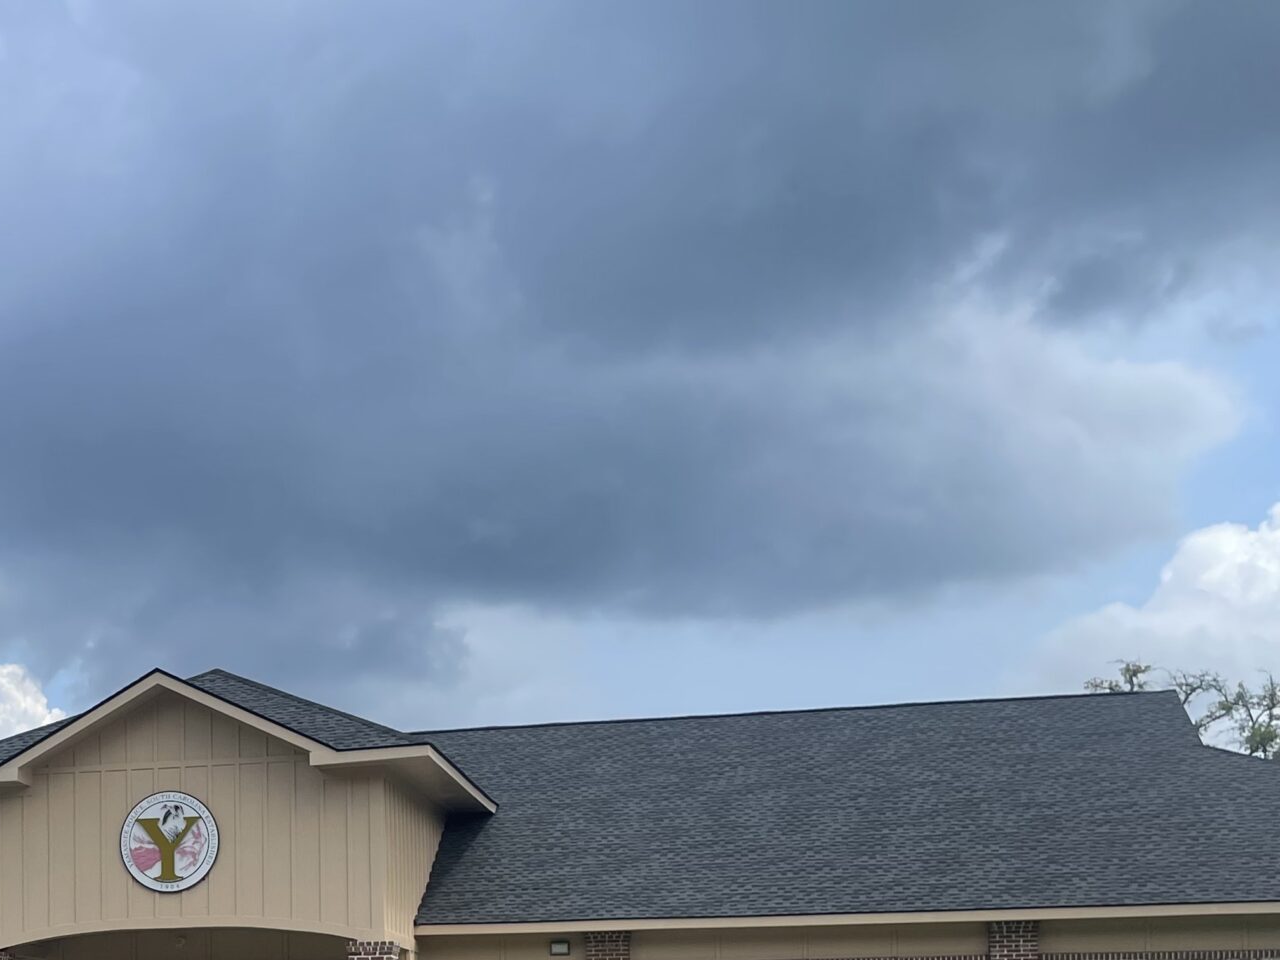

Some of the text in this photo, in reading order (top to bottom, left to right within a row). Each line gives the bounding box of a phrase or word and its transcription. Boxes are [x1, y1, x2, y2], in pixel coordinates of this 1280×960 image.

[147, 794, 170, 804] SOUTH
[173, 793, 206, 815] CAROLINA
[136, 816, 201, 880] Y
